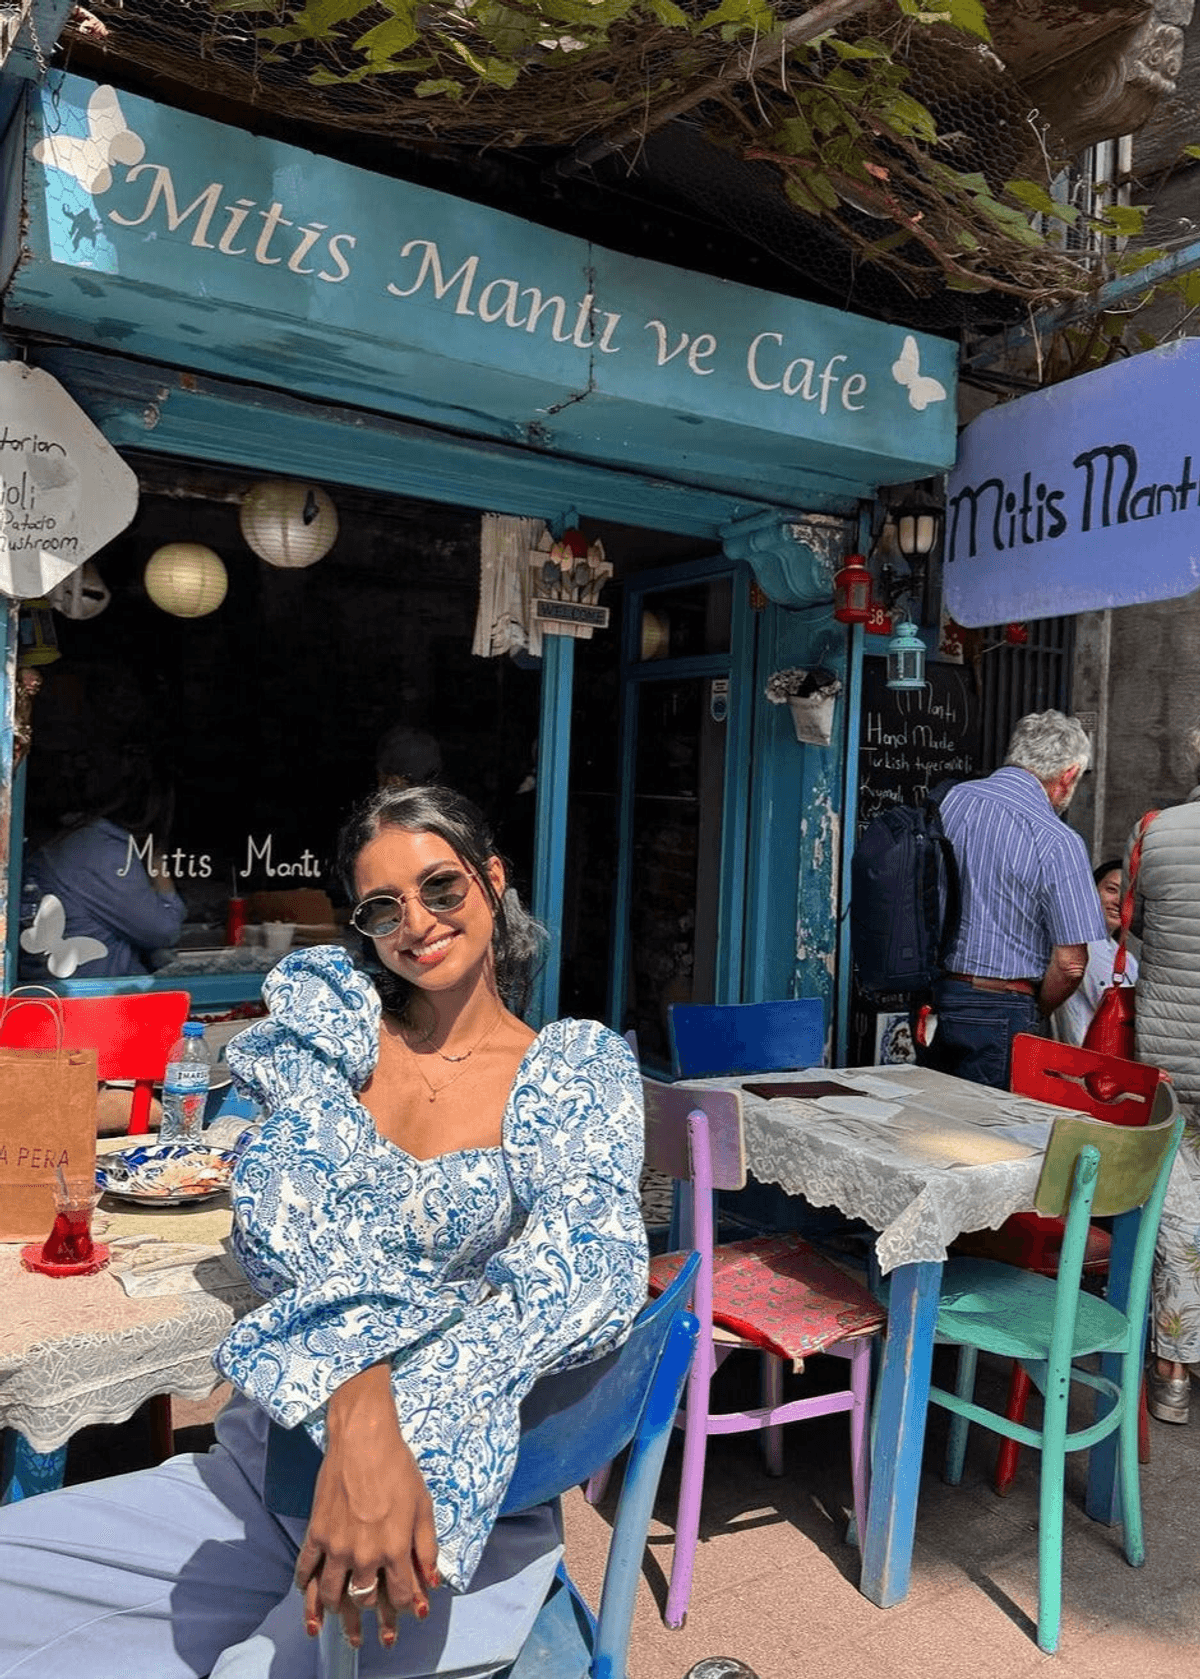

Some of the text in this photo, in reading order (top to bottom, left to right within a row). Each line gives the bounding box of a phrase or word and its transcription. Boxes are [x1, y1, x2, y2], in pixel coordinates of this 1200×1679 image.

[108, 164, 357, 282] Mitis
[644, 320, 716, 374] ve
[747, 333, 867, 414] Cafe
[949, 444, 1200, 562] Mitis Mant
[867, 711, 954, 751] Hand Made
[116, 833, 212, 878] Mitis
[17, 1147, 69, 1168] PERA
